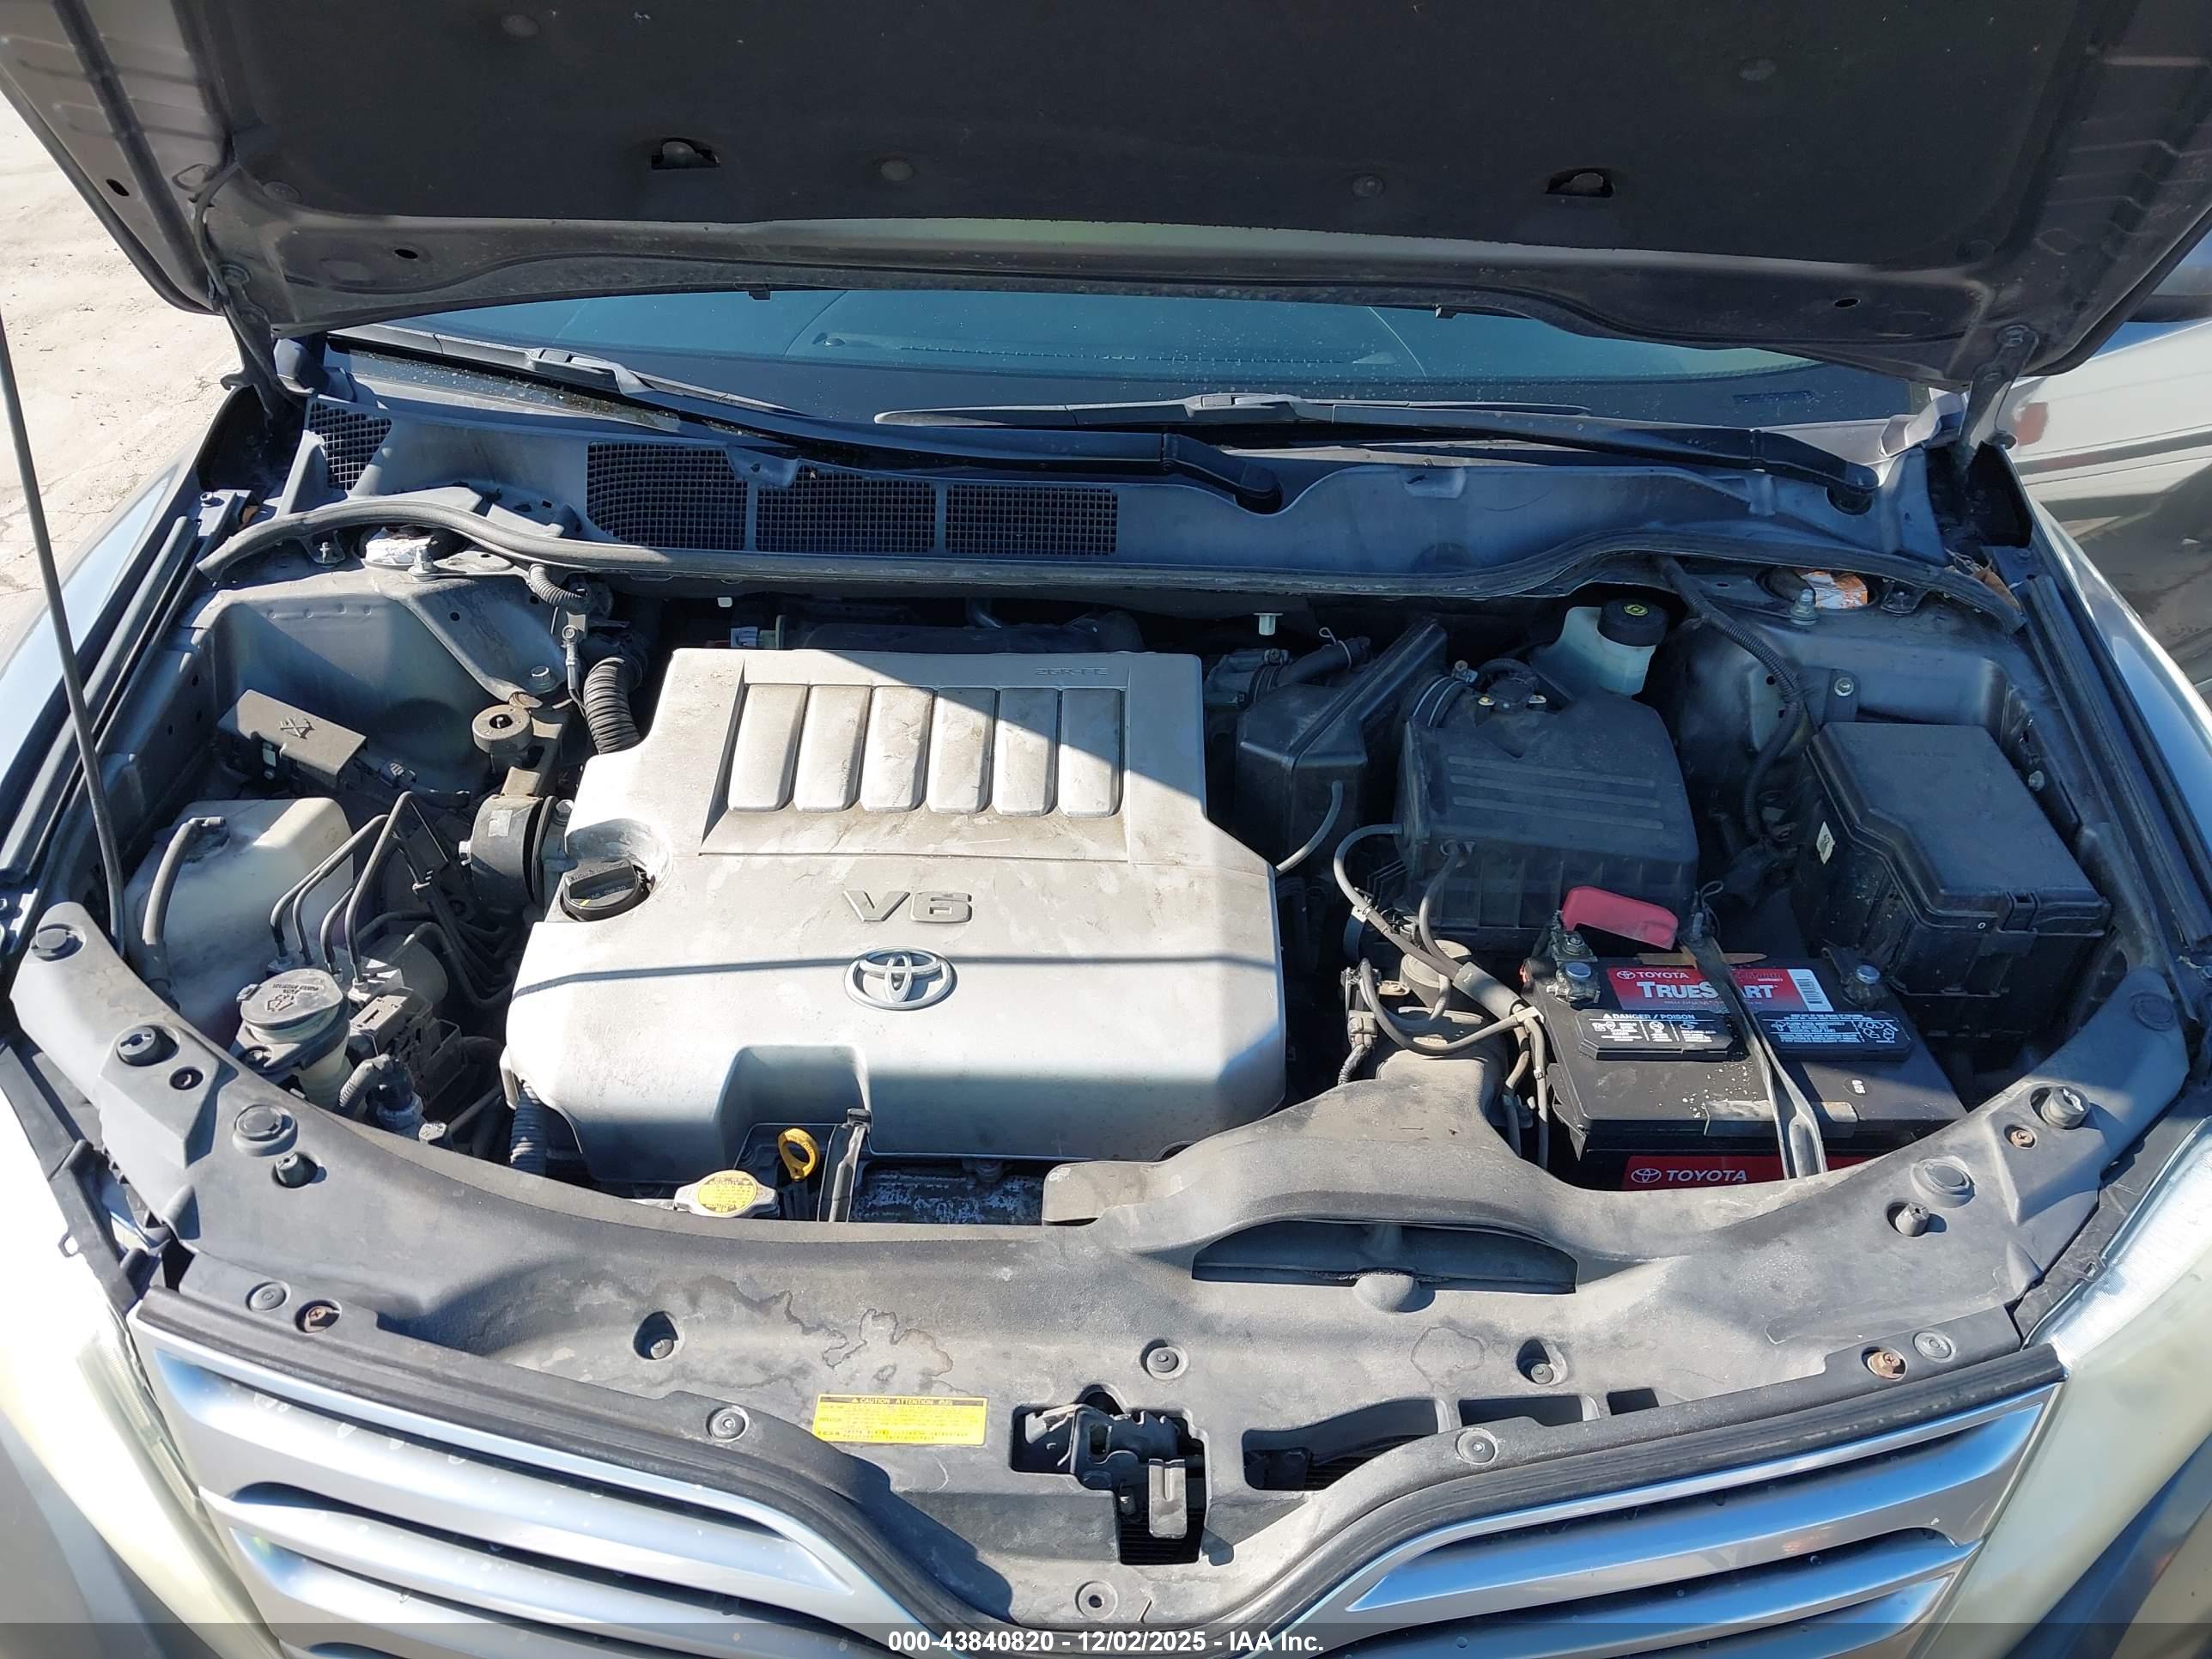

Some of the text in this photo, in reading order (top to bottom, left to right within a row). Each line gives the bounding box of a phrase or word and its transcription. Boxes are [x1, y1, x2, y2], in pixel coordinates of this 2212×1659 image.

[1036, 667, 1108, 676] 2GR-FE
[842, 890, 972, 924] V6
[1667, 1170, 1747, 1182] TOYOTA
